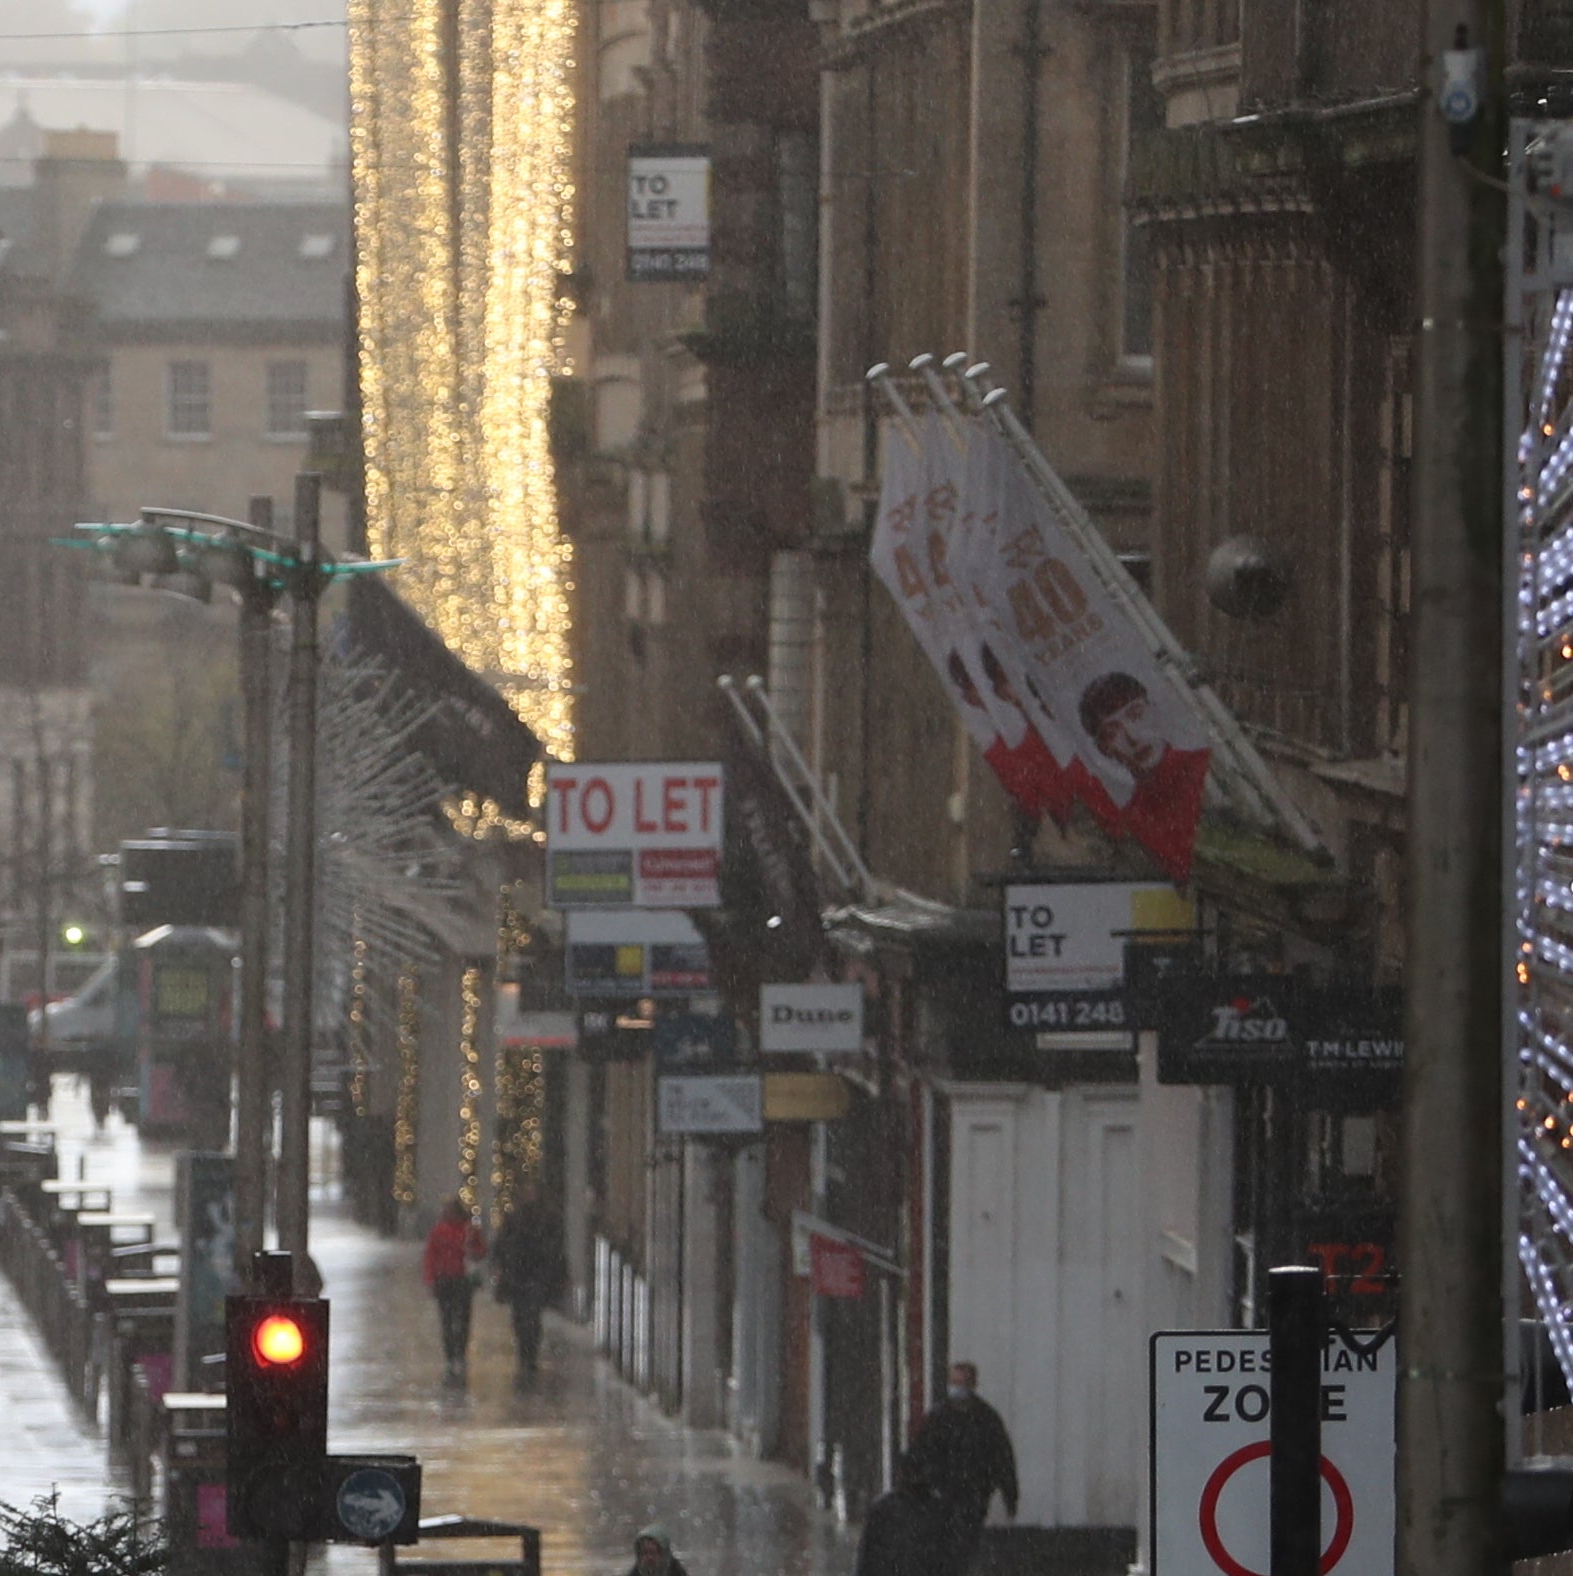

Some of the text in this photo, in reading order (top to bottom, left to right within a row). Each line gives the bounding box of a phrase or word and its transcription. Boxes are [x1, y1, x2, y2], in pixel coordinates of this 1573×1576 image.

[632, 175, 667, 194] TO
[632, 200, 676, 219] LET
[1006, 557, 1088, 642] 40
[552, 776, 719, 835] TO LET
[1010, 906, 1054, 929] TO
[1010, 935, 1067, 957] LET
[772, 1005, 853, 1024] Dune
[1009, 1002, 1069, 1027] 0141
[1308, 1242, 1386, 1294] T2
[1203, 1384, 1347, 1423] ZOE
